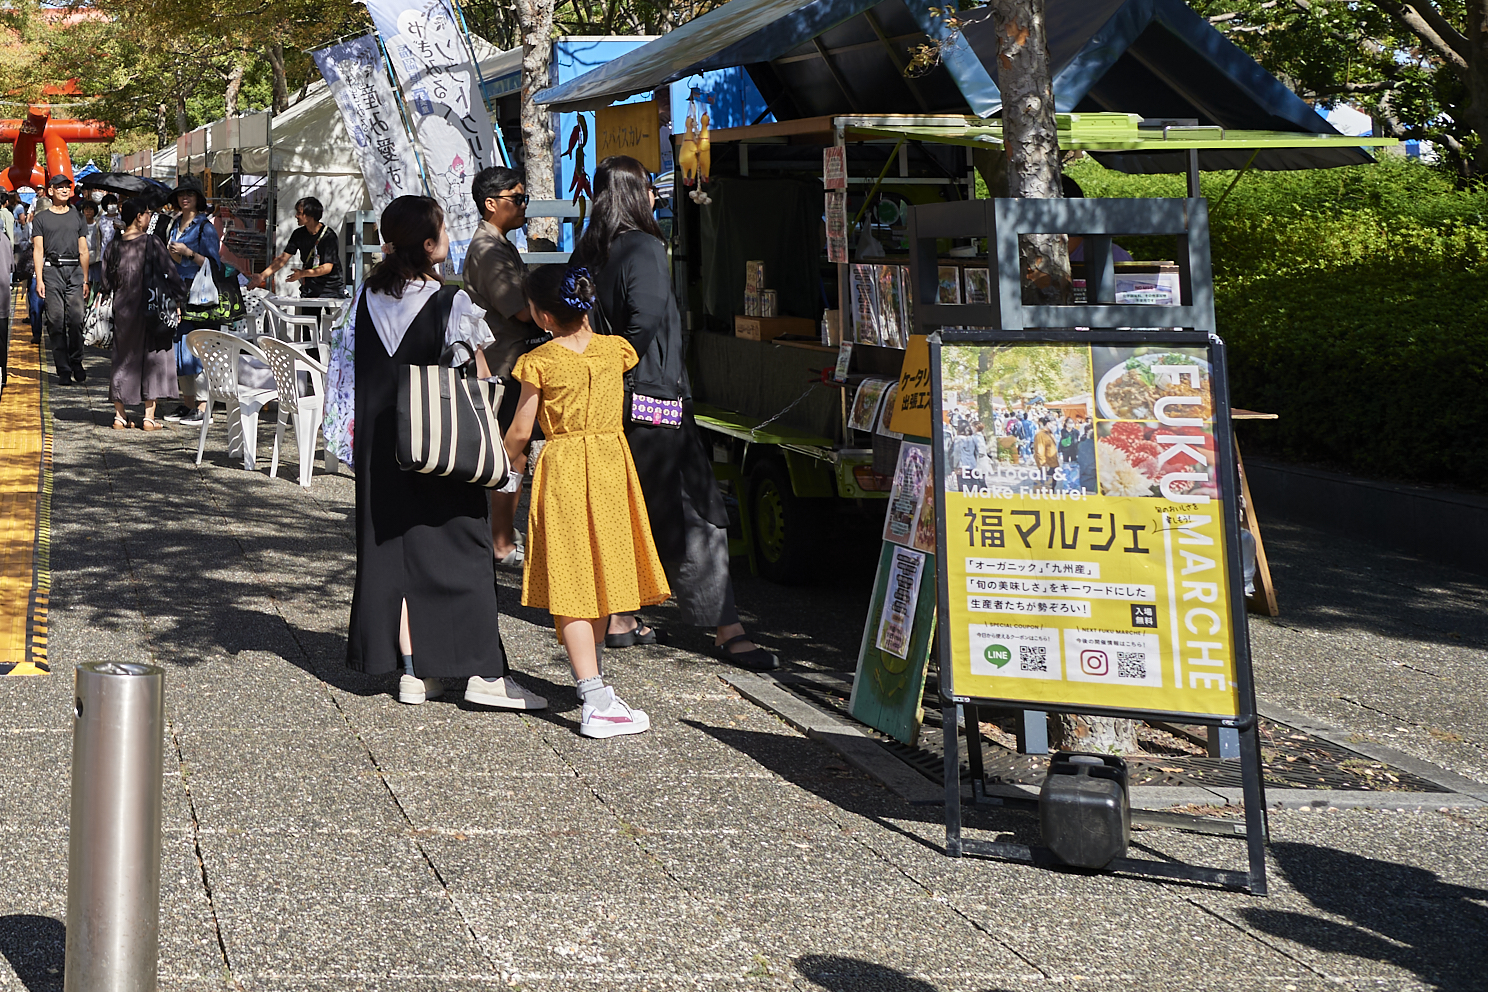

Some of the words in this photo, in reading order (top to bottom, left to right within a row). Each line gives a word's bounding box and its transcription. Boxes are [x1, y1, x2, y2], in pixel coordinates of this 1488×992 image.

[602, 126, 649, 150] スパイスカレー
[1151, 364, 1210, 504] FUKU
[997, 466, 1046, 481] Local
[1053, 466, 1067, 481] &
[962, 484, 1013, 499] Make
[1020, 485, 1087, 501] Future!
[964, 507, 1150, 554] 福マルシェ
[970, 579, 1147, 598] 「旬の美味しさ」をキーワードにした
[987, 650, 1008, 660] LINE
